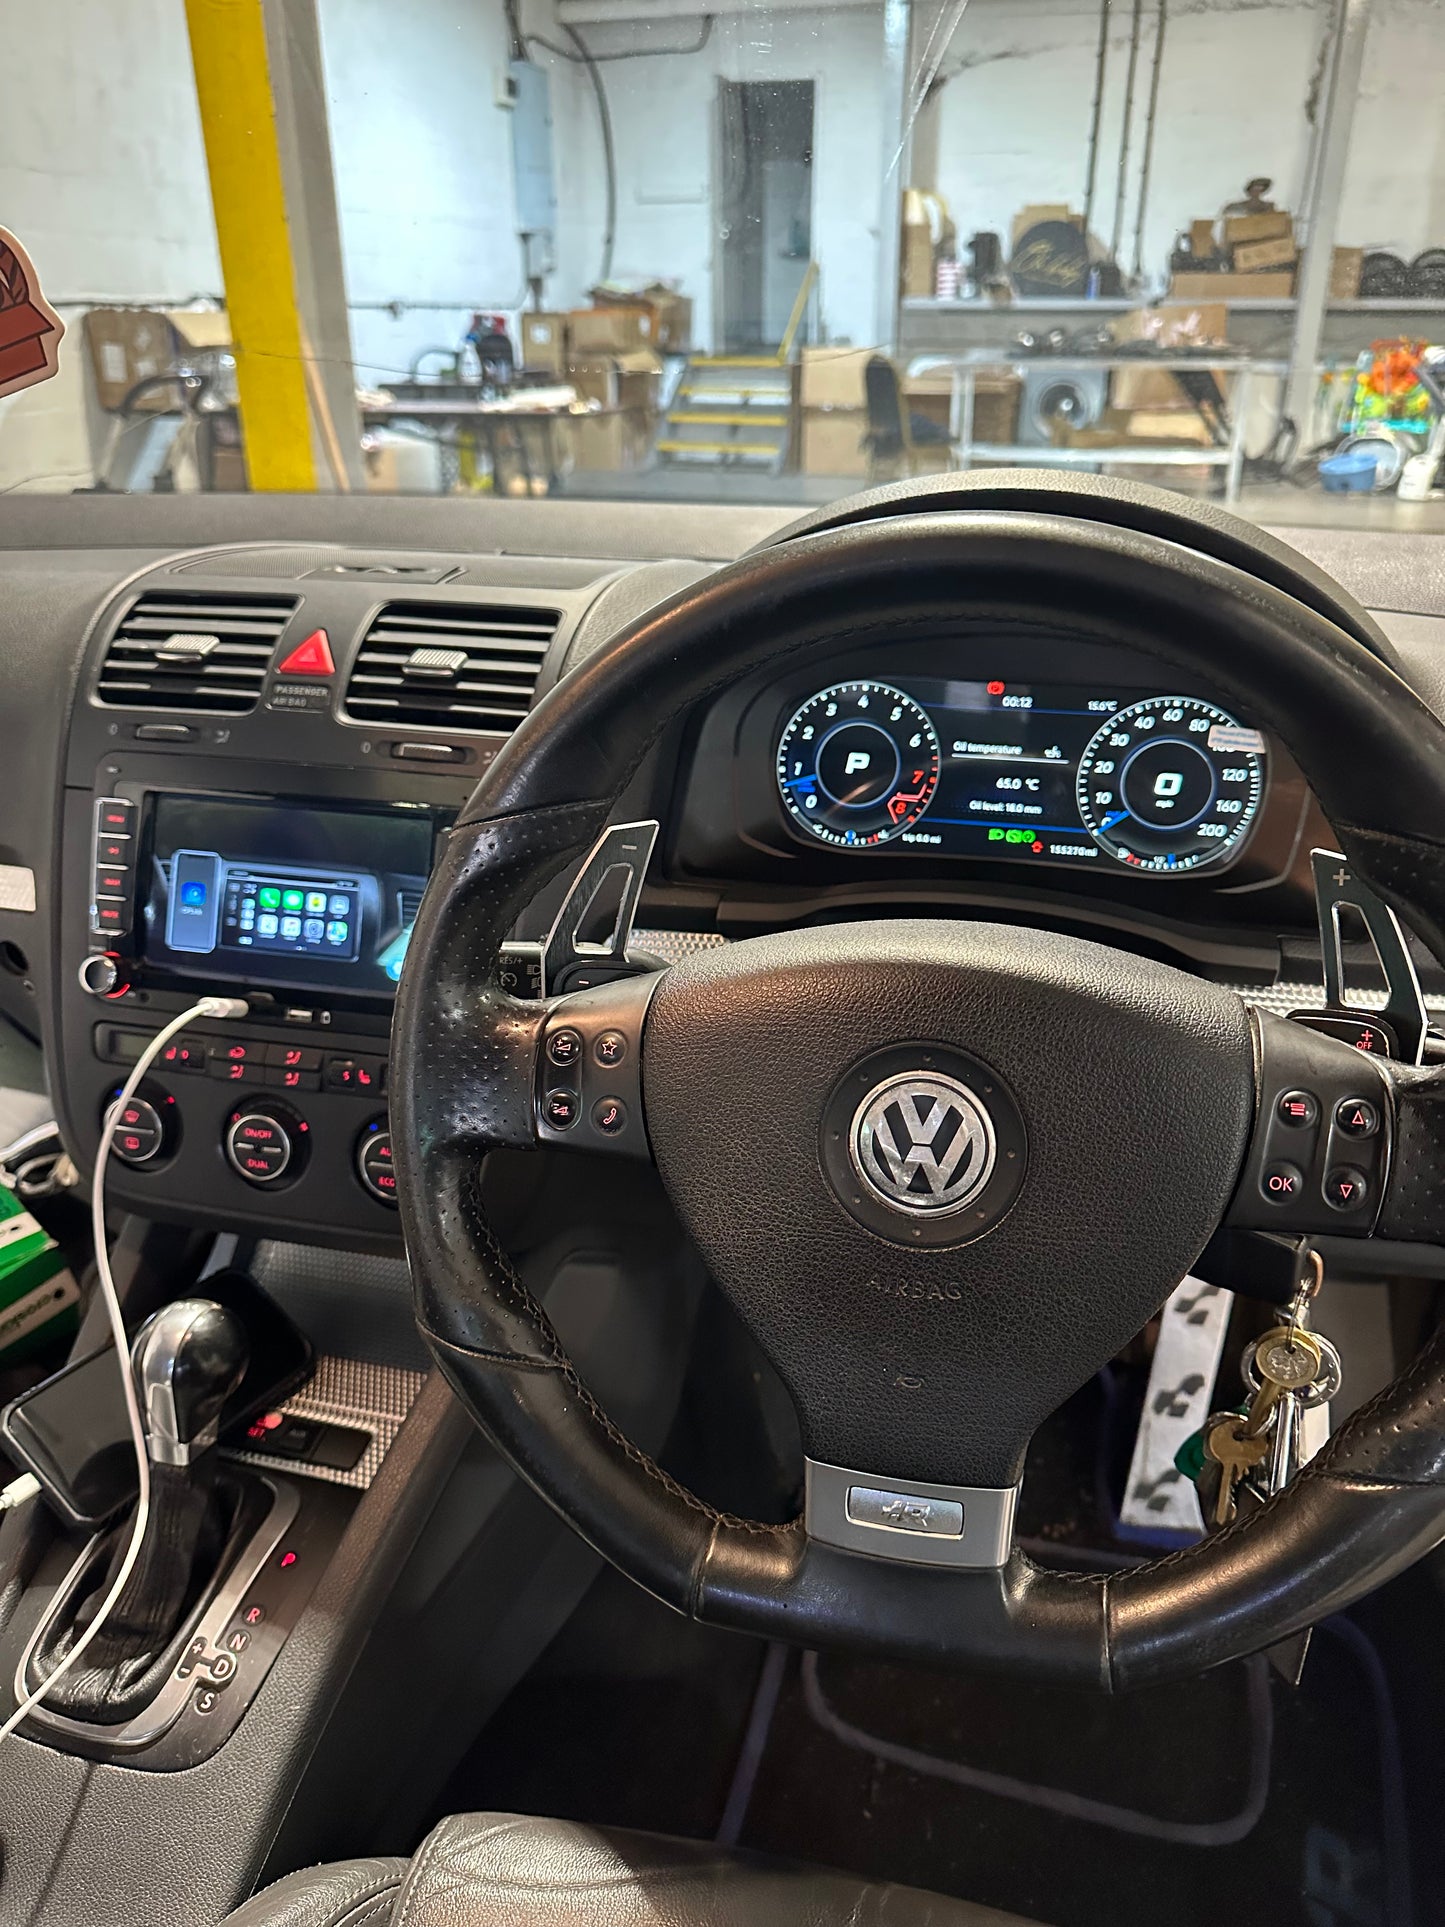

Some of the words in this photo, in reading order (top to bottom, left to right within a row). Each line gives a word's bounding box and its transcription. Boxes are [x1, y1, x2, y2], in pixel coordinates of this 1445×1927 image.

[858, 695, 869, 708] 4
[825, 703, 838, 717] 3
[890, 706, 902, 721] 5
[1162, 708, 1184, 722] 60
[1134, 716, 1156, 730] 40
[1189, 718, 1211, 732] 80
[802, 726, 814, 740] 2
[909, 733, 922, 747] 6
[1109, 733, 1131, 747] 30
[953, 740, 968, 752] Oil
[968, 742, 1023, 755] temperature
[794, 761, 803, 776] 1
[844, 752, 871, 775] P
[1094, 760, 1115, 775] 20
[912, 769, 924, 784] 7
[1222, 768, 1249, 782] 120
[1153, 772, 1184, 796] 0
[805, 794, 818, 809] 0
[1095, 791, 1113, 805] 10
[895, 801, 907, 816] 8
[1216, 799, 1243, 813] 160
[1197, 823, 1228, 838] 200
[1356, 1041, 1374, 1051] OFF
[244, 1127, 273, 1139] ON/OFF
[247, 1158, 269, 1170] DUAL
[1269, 1176, 1294, 1192] OK
[866, 1272, 962, 1300] AIRBAG
[246, 1607, 261, 1623] R
[230, 1633, 247, 1650] N
[214, 1659, 229, 1674] D
[200, 1692, 215, 1709] S
